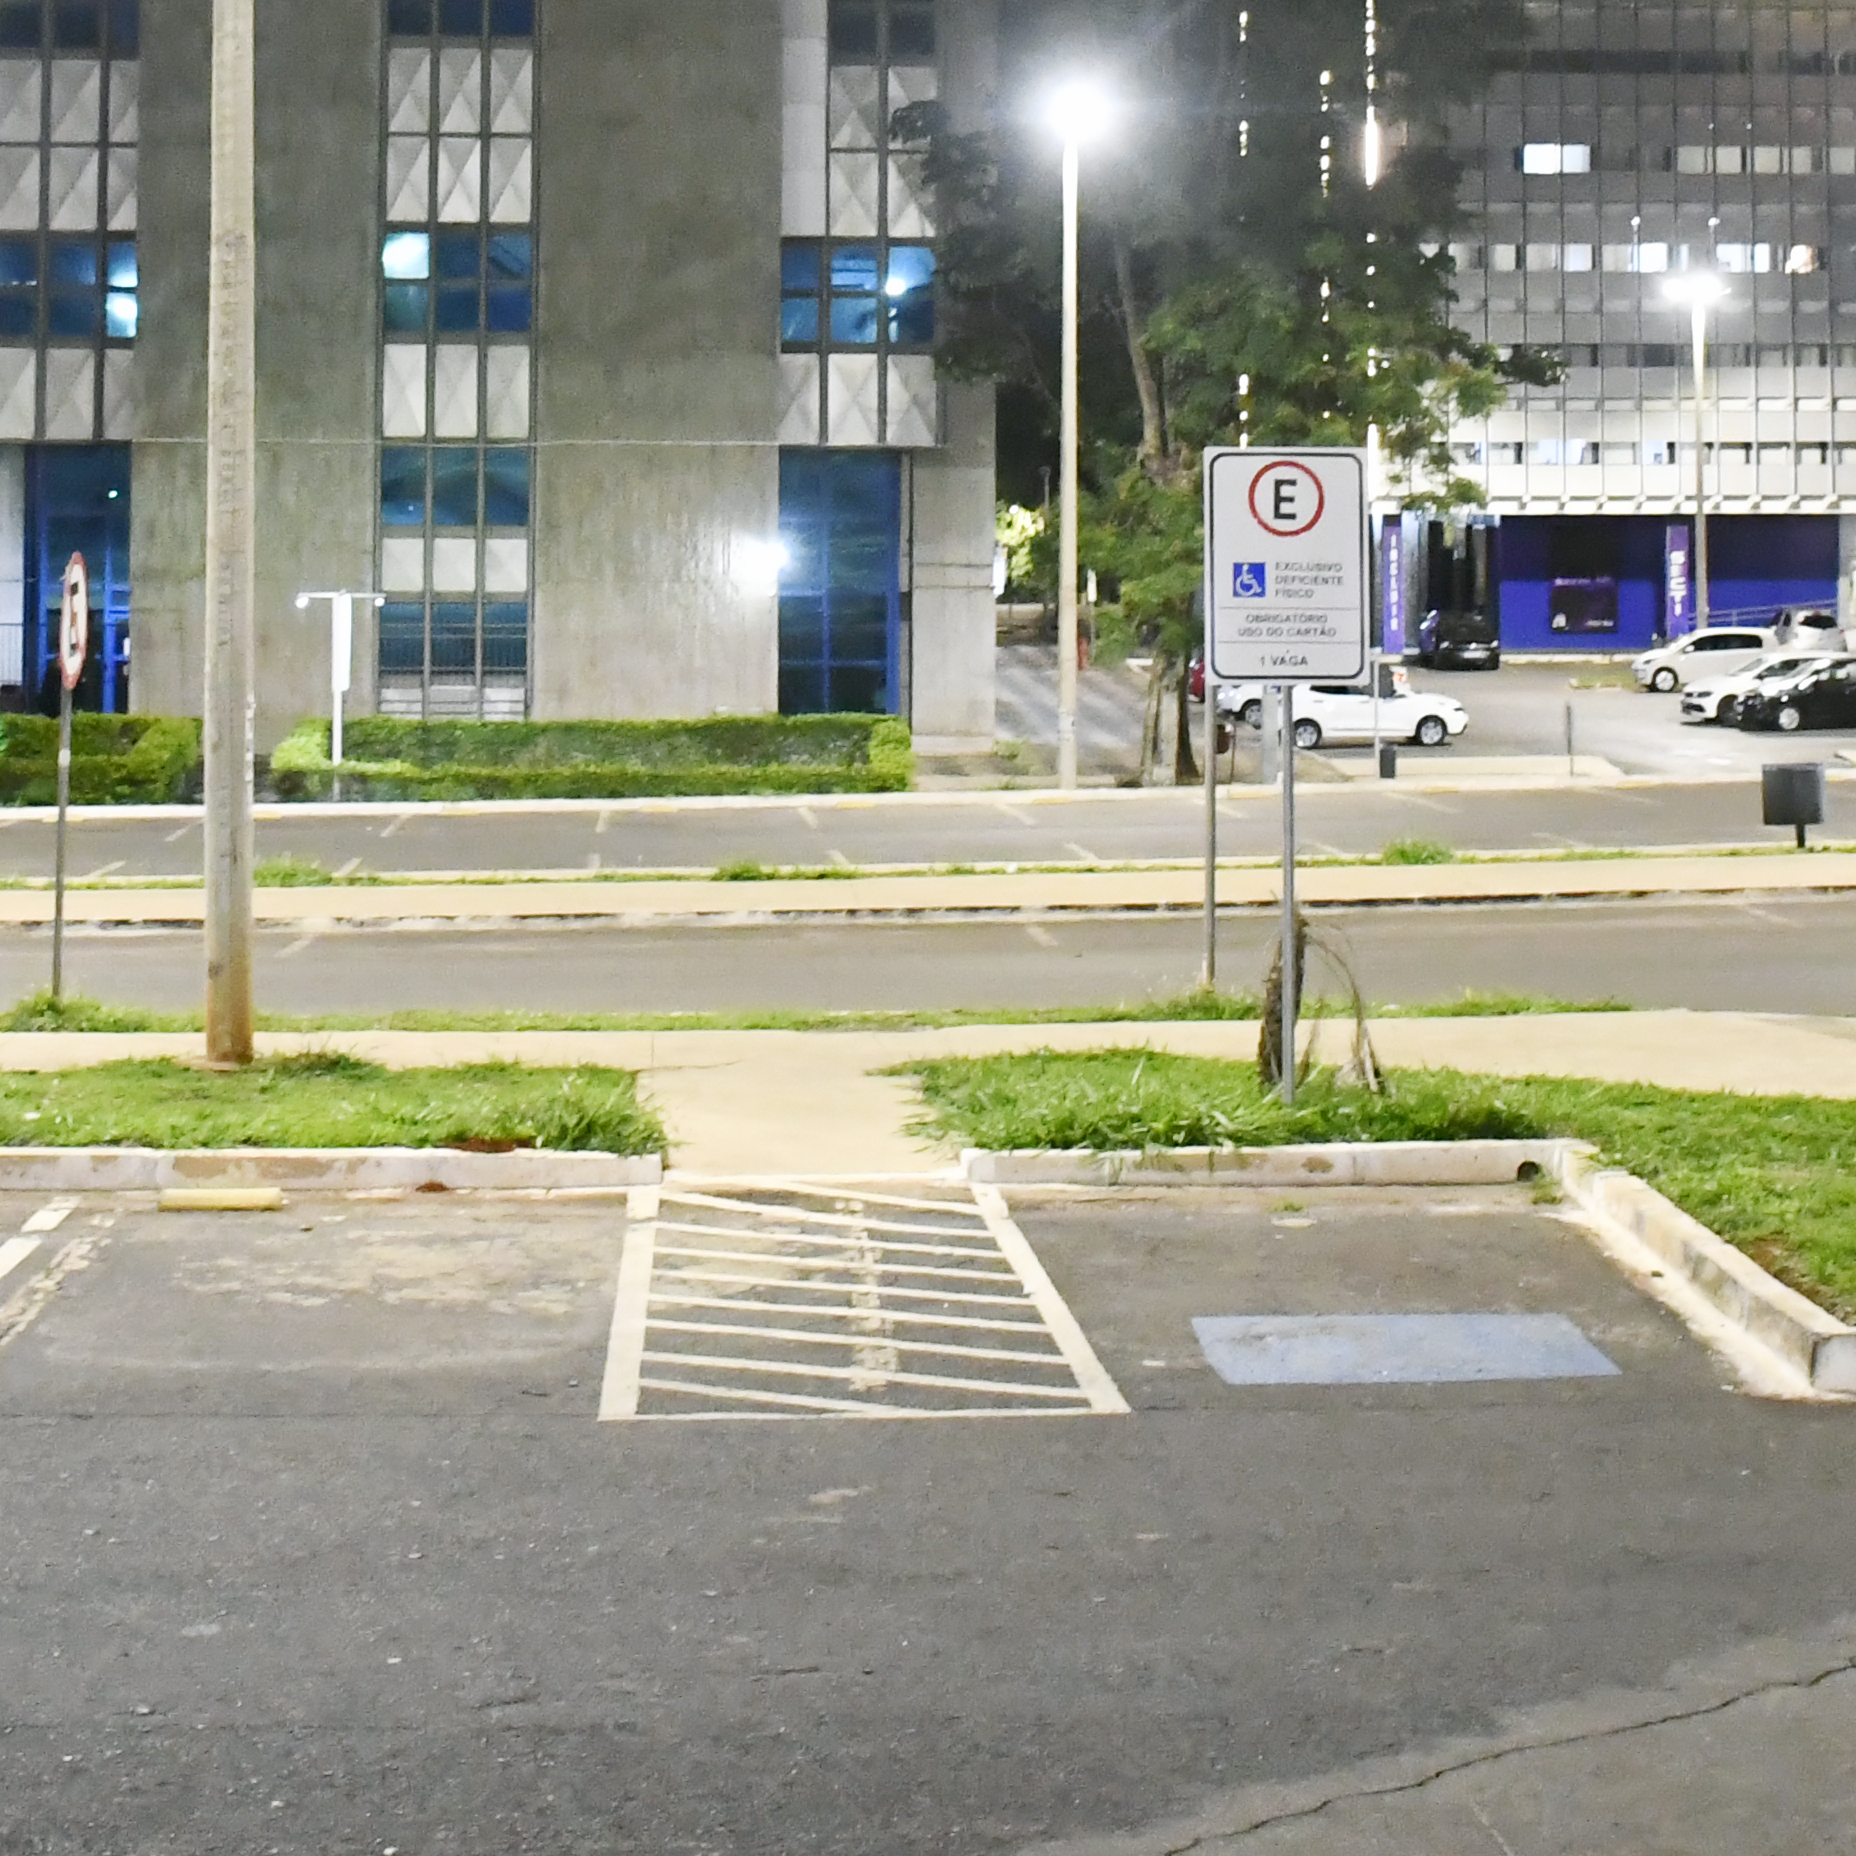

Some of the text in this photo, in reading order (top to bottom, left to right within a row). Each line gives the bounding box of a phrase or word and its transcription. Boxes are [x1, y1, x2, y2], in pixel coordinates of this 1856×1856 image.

[1273, 479, 1297, 520] E
[1274, 562, 1343, 573] EXCLUSIVO
[1274, 575, 1344, 586] DEFICIENTE
[1238, 627, 1263, 637] USO
